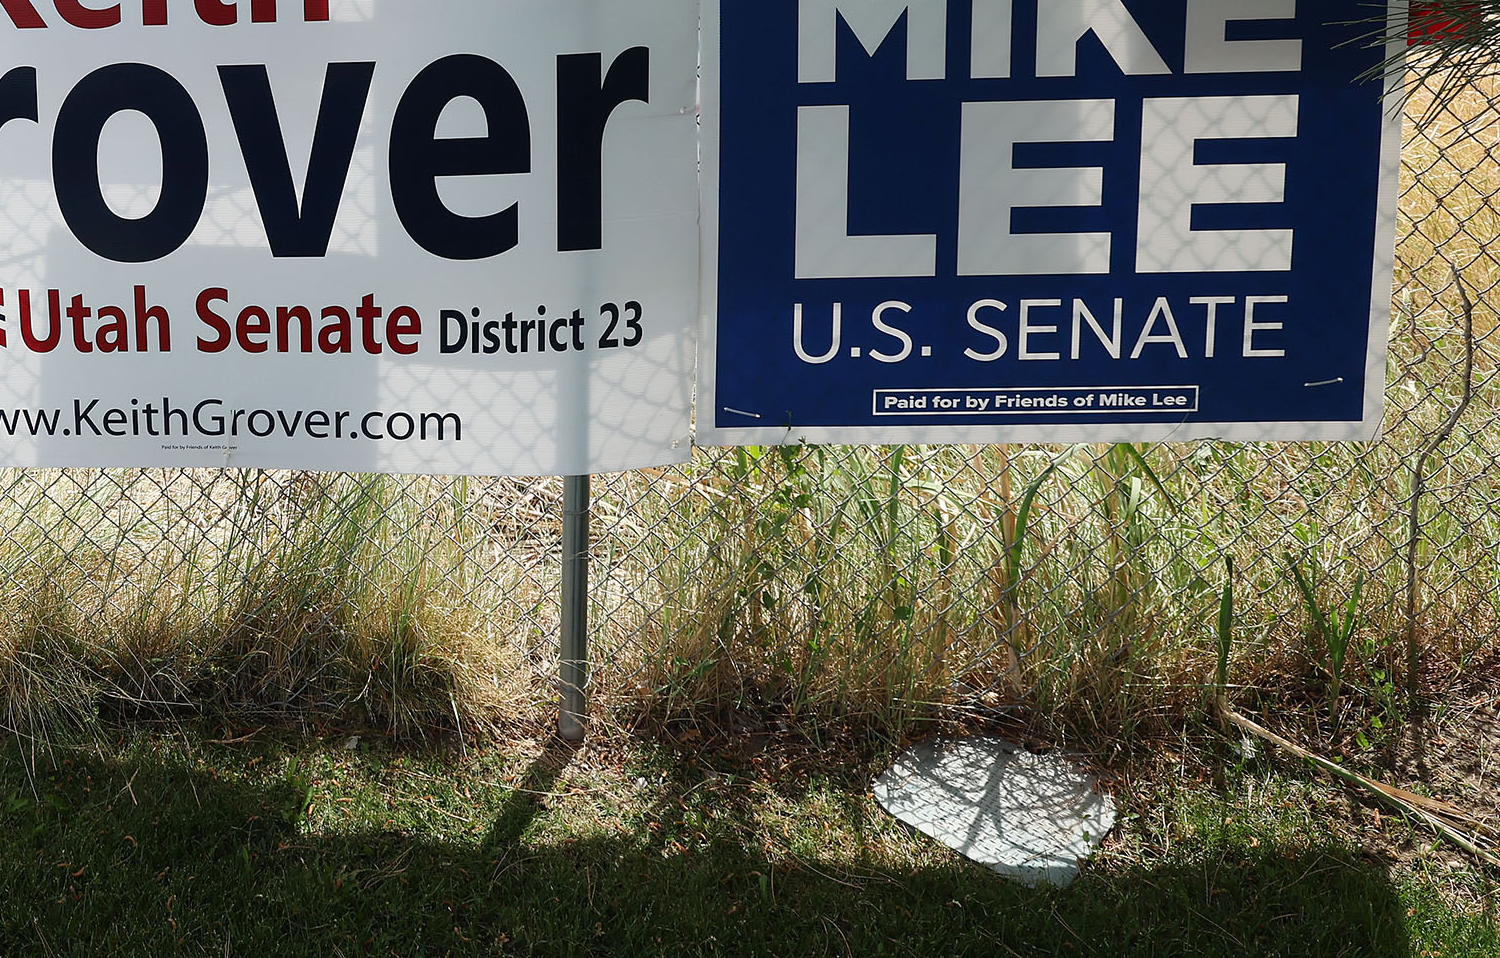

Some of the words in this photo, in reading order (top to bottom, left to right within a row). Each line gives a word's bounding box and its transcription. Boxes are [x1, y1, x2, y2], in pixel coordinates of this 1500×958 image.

[794, 94, 1299, 279] LEE
[18, 284, 173, 355] Utah
[196, 286, 422, 356] Senate
[439, 303, 585, 355] District
[597, 301, 645, 350] 23
[792, 300, 932, 364] U.S.
[965, 294, 1288, 361] SENATE
[884, 394, 928, 410] Paid
[931, 393, 961, 409] for
[965, 394, 990, 414] by
[994, 392, 1068, 409] Friends
[1072, 391, 1095, 408] of
[1098, 391, 1147, 408] Mike
[1151, 391, 1187, 407] Lee
